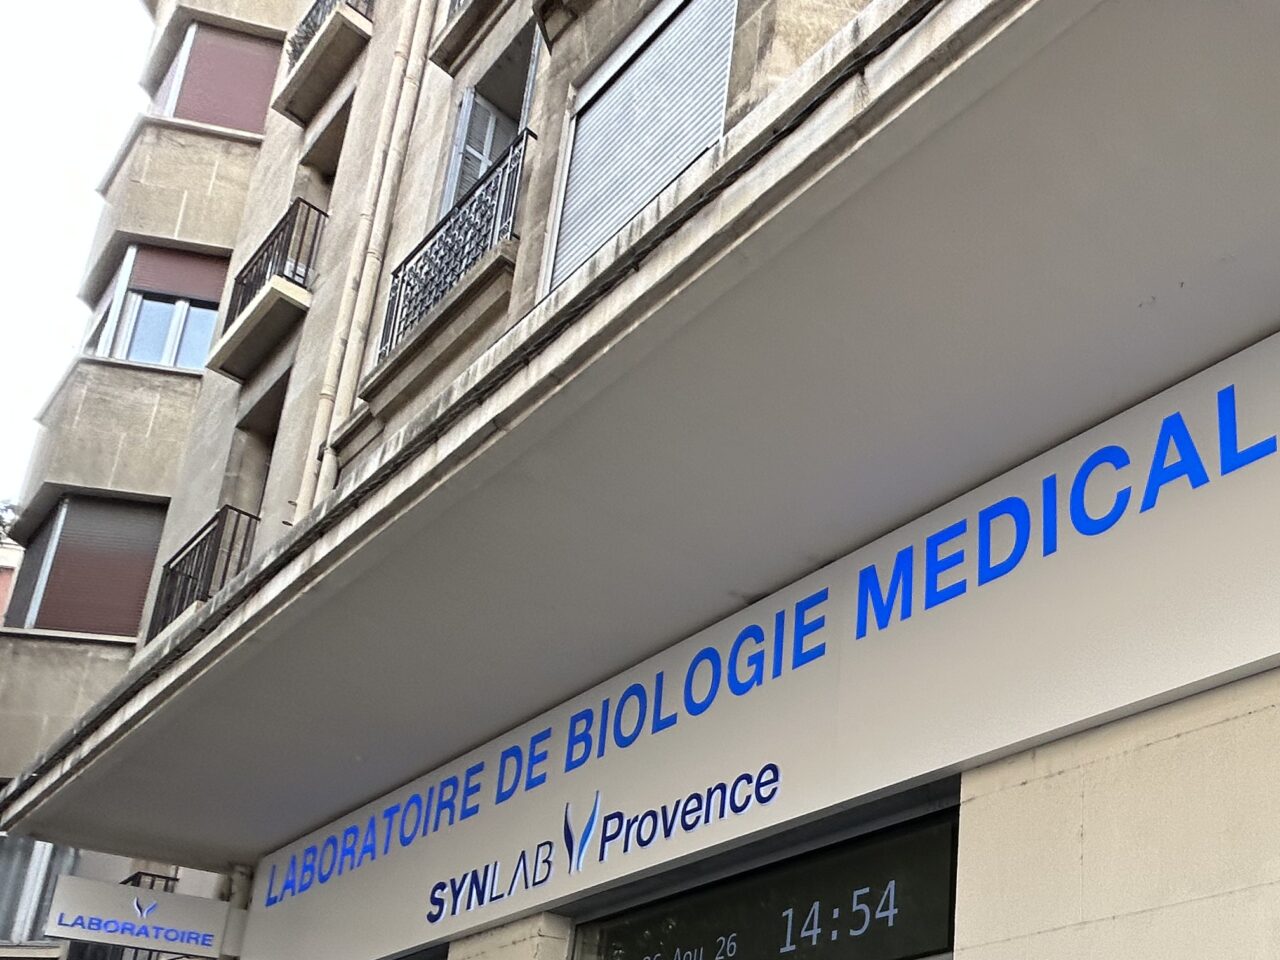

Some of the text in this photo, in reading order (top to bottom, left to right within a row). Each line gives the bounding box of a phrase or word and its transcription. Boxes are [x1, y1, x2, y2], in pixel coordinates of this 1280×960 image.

[264, 761, 486, 907] LABORATOIRE
[495, 727, 553, 805] DE
[565, 588, 830, 771] BIOLOGIE
[426, 762, 782, 925] SYNLAB Provence
[57, 912, 215, 948] LABORATOIRE
[715, 932, 738, 960] 26
[778, 880, 899, 954] 14:54
